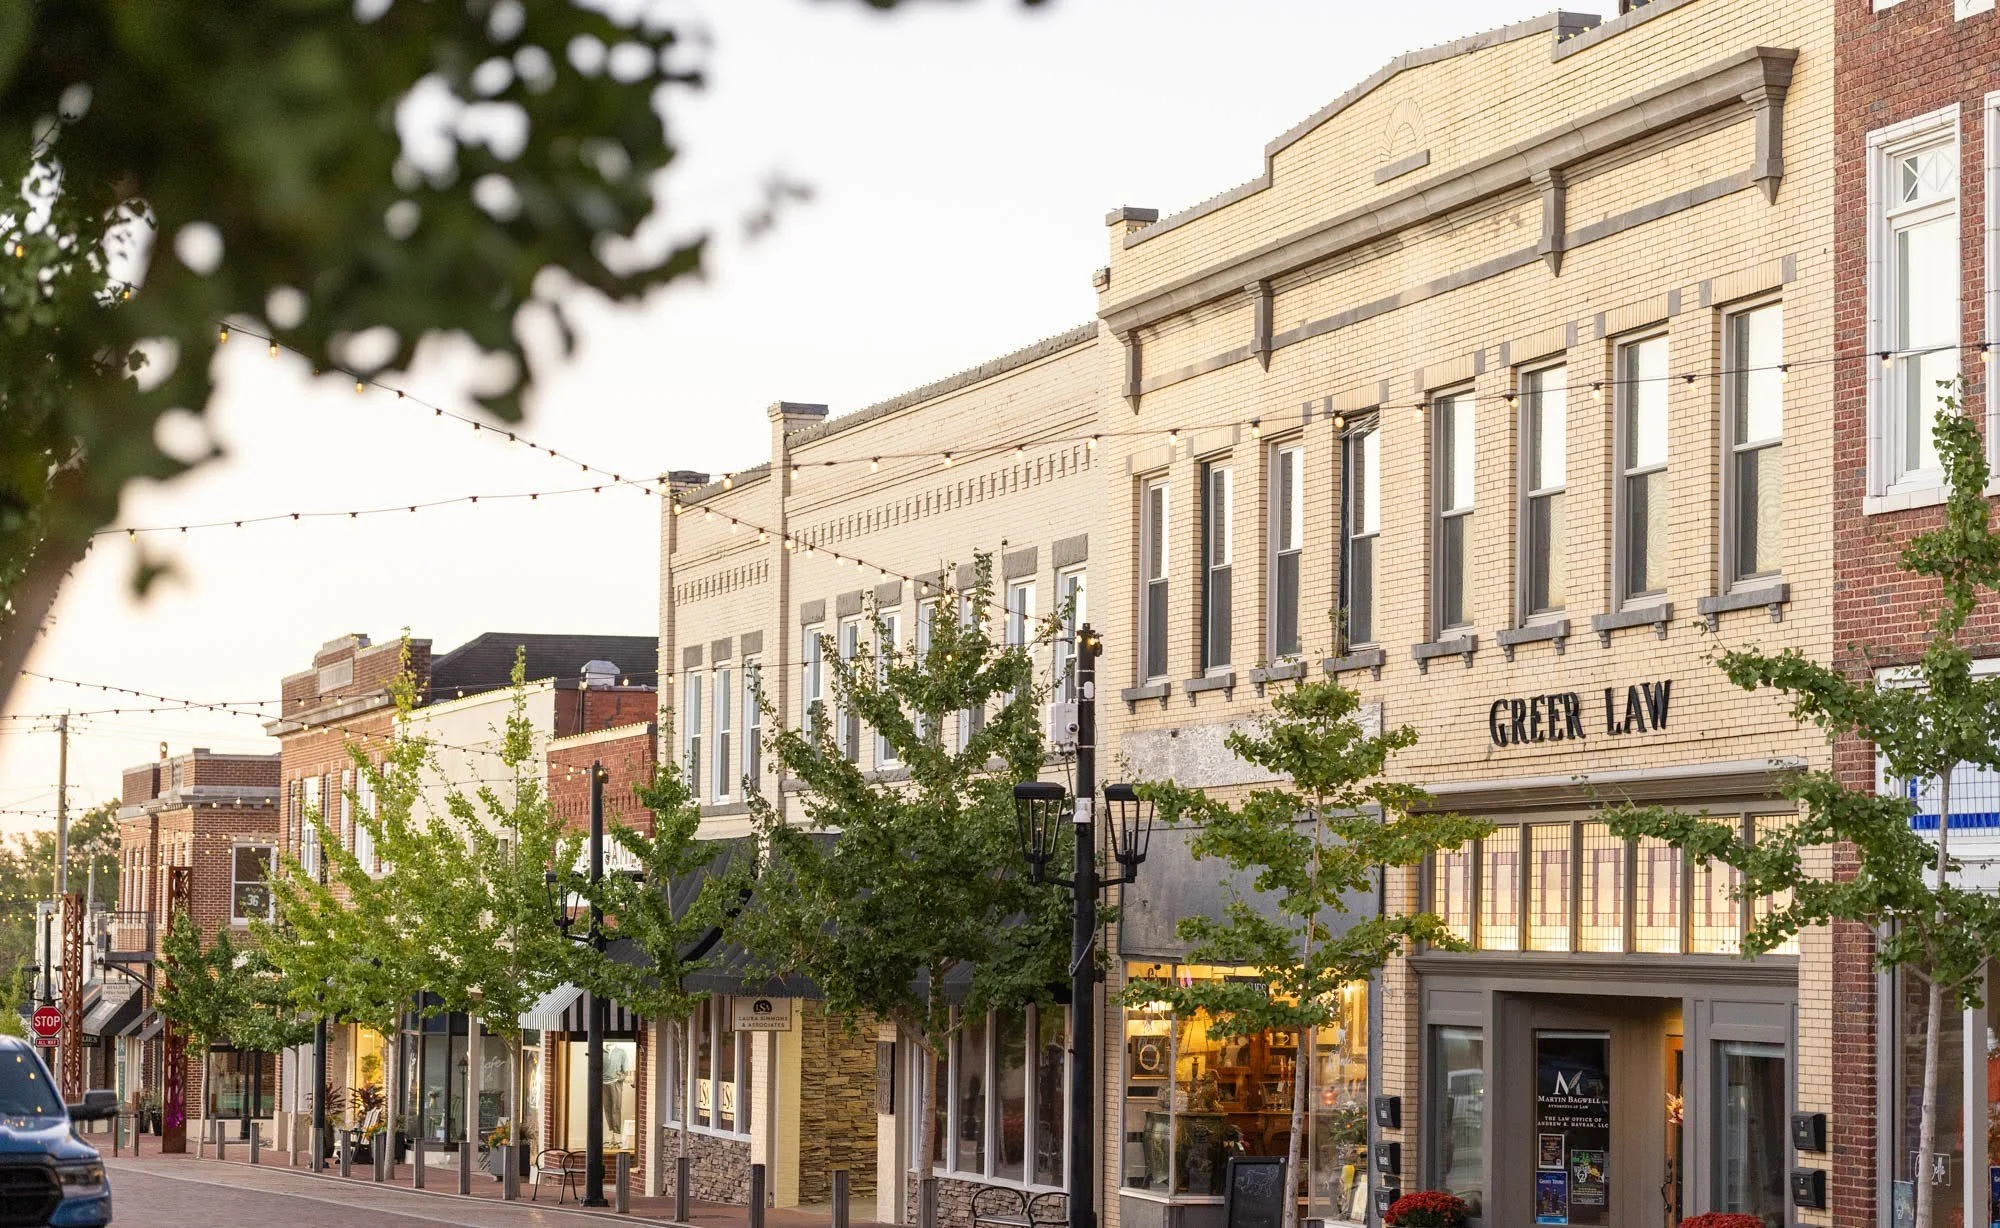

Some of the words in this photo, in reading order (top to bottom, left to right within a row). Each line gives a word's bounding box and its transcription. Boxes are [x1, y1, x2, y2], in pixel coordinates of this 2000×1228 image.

[1489, 692, 1586, 748] GREER
[1605, 679, 1673, 736] LAW
[247, 894, 259, 907] 36
[34, 1015, 60, 1027] STOP
[1537, 1095, 1567, 1103] MARTIN
[1568, 1096, 1601, 1104] BAGWELL
